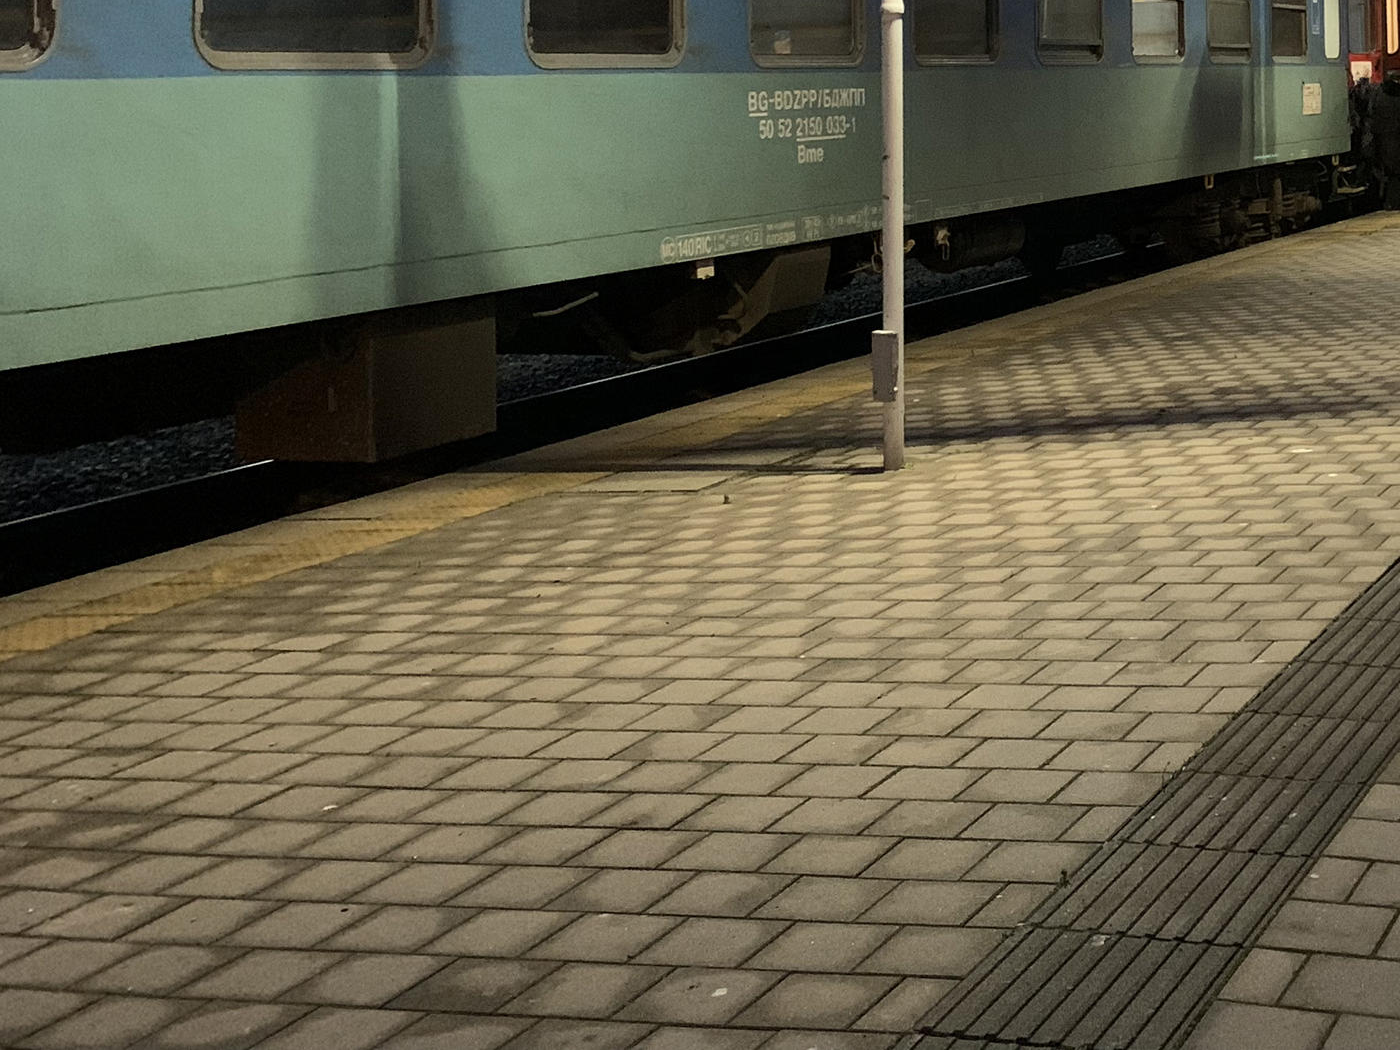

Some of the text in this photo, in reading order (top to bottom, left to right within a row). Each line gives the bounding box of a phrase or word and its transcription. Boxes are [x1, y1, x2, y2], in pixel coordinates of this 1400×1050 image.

[759, 119, 775, 139] 50
[778, 118, 793, 137] 52
[796, 117, 823, 137] 2150
[797, 145, 824, 164] Bme
